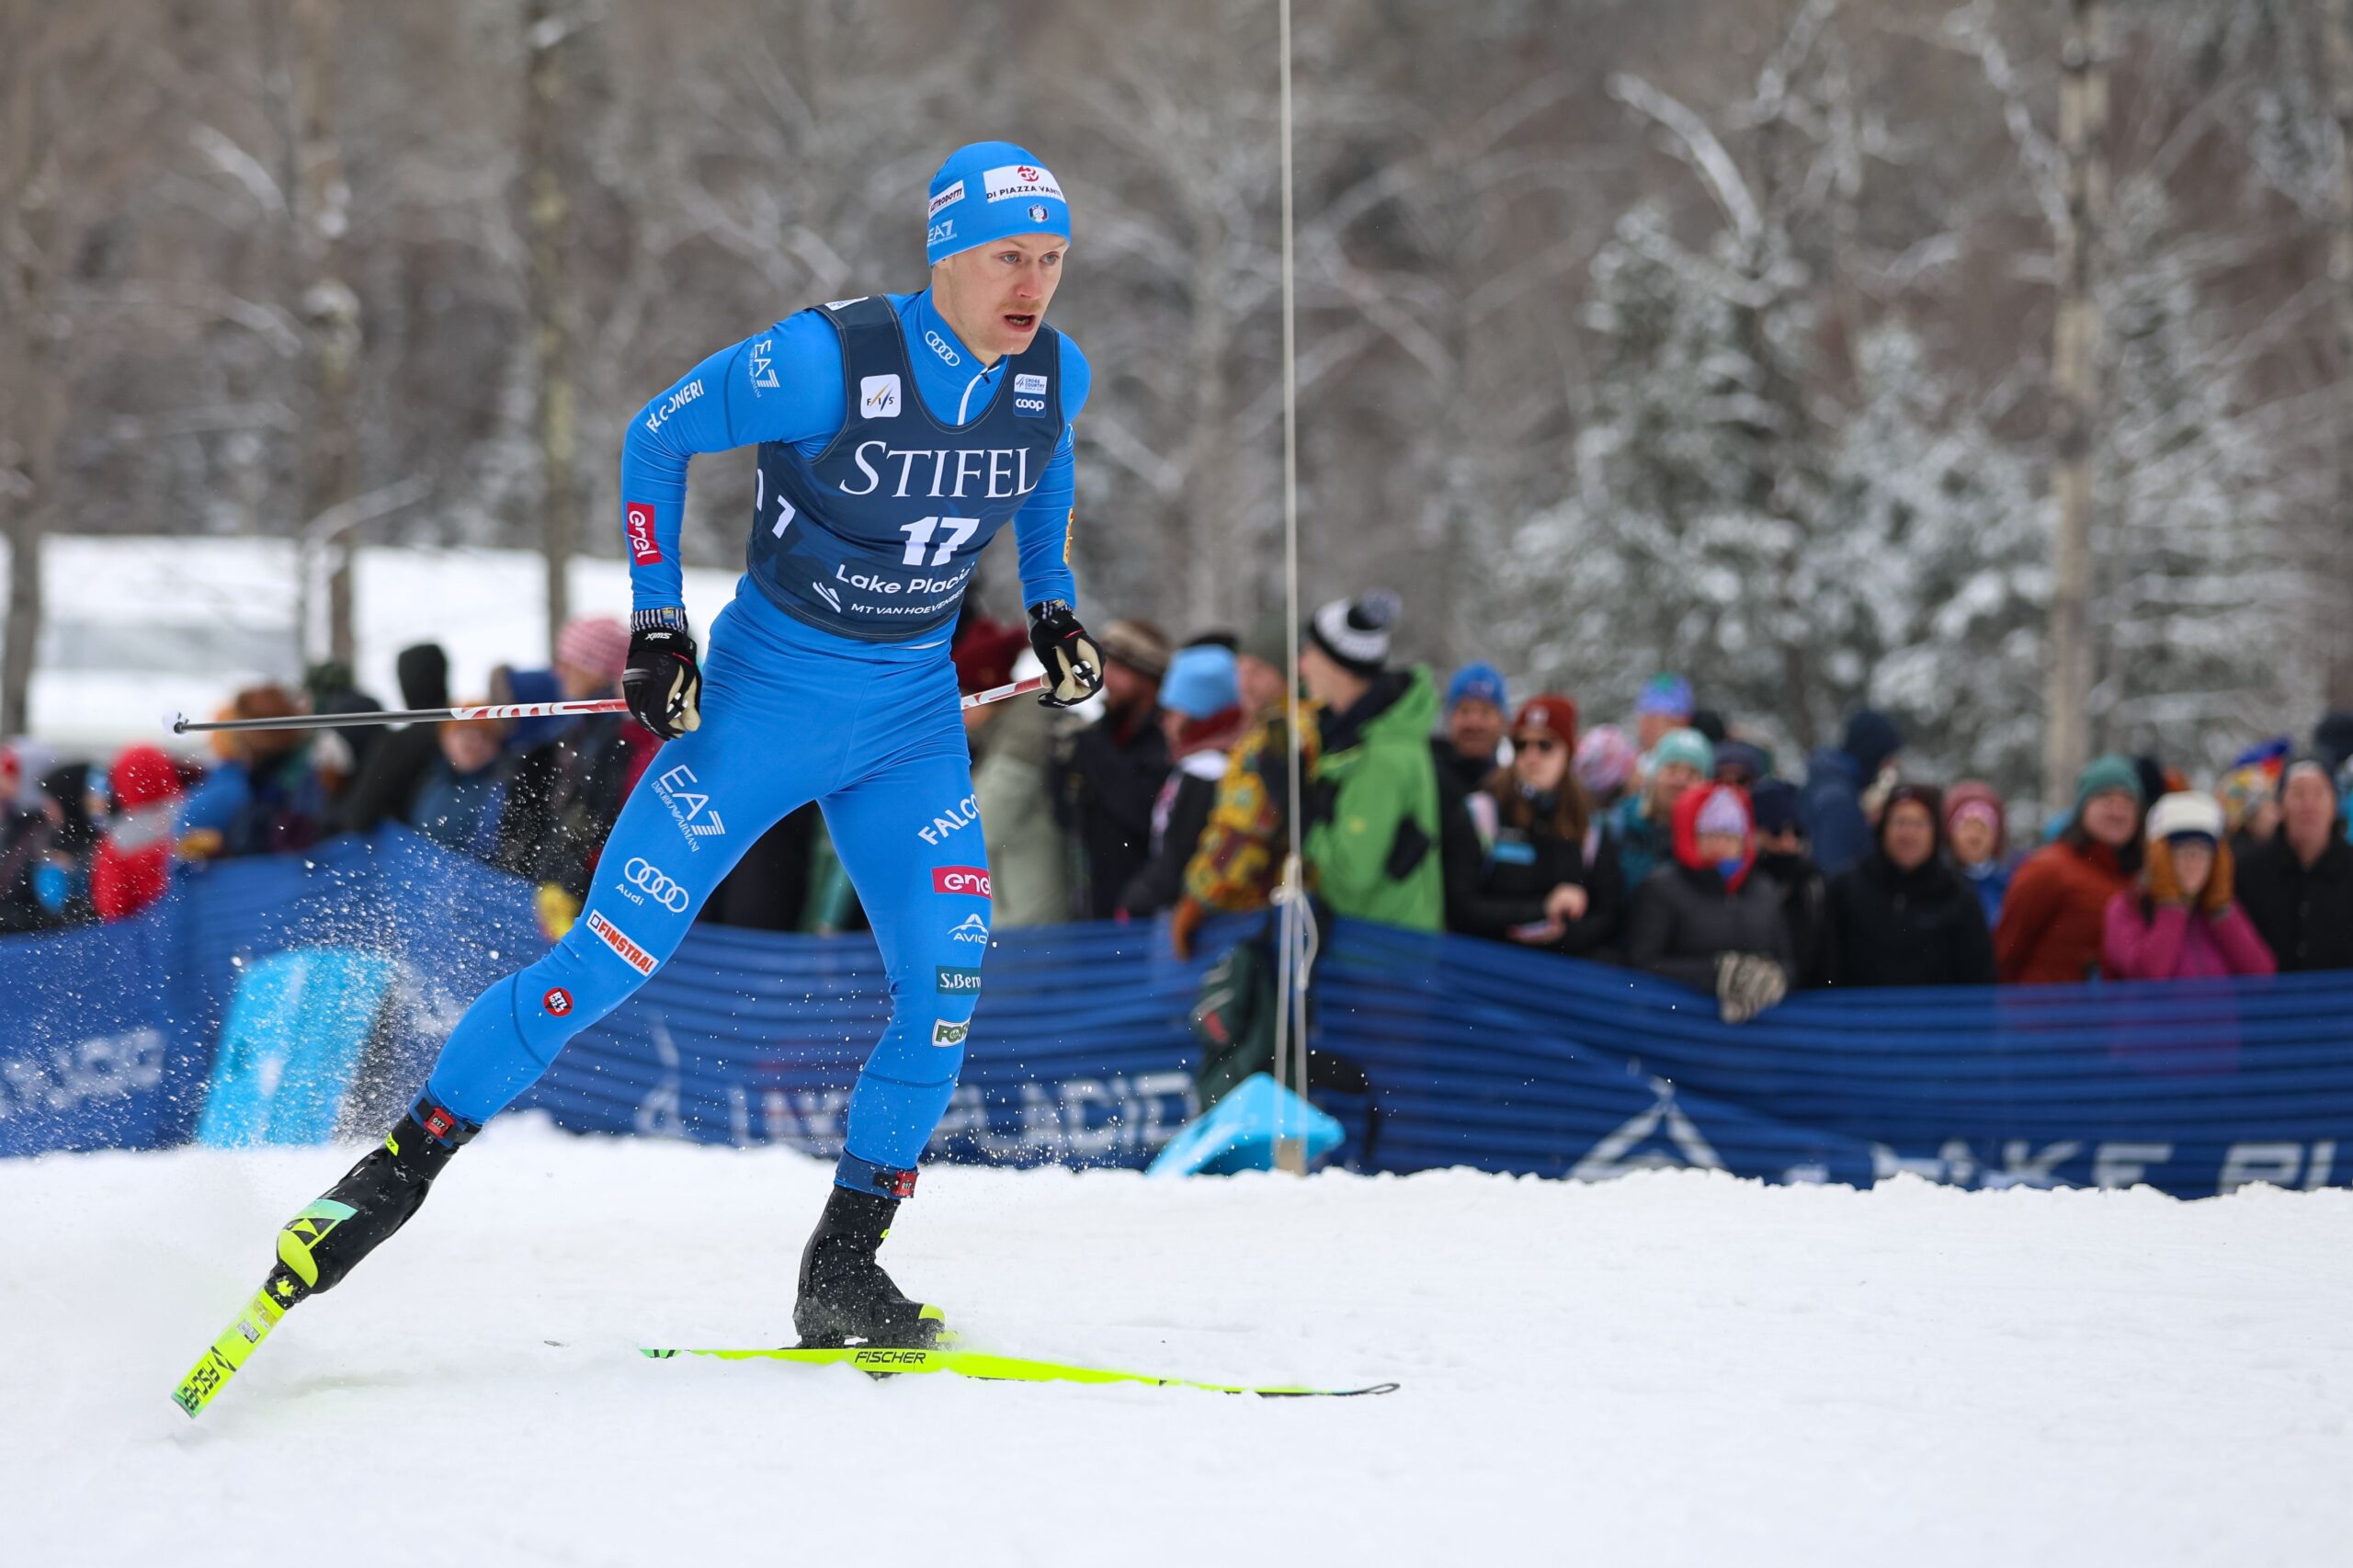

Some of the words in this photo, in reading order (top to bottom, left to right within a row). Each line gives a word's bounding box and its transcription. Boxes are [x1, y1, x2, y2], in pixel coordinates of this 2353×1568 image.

[986, 191, 996, 199] DI
[999, 186, 1037, 196] PIAZZA
[754, 339, 780, 388] EA7
[1015, 398, 1045, 412] coop
[839, 440, 1039, 499] STIFEL
[899, 516, 980, 567] 17
[835, 563, 902, 594] Lake
[851, 603, 874, 614] MT
[876, 607, 904, 615] VAN
[904, 585, 967, 615] HOEVENBER
[651, 780, 677, 812] EMPORIO
[676, 814, 700, 853] ARMANI
[659, 764, 726, 835] EA7
[615, 882, 644, 906] Audi
[598, 920, 655, 974] FINSTRAL
[552, 991, 569, 1010] RTL
[854, 1350, 927, 1365] FISCHER
[181, 1359, 222, 1412] FISCHER
